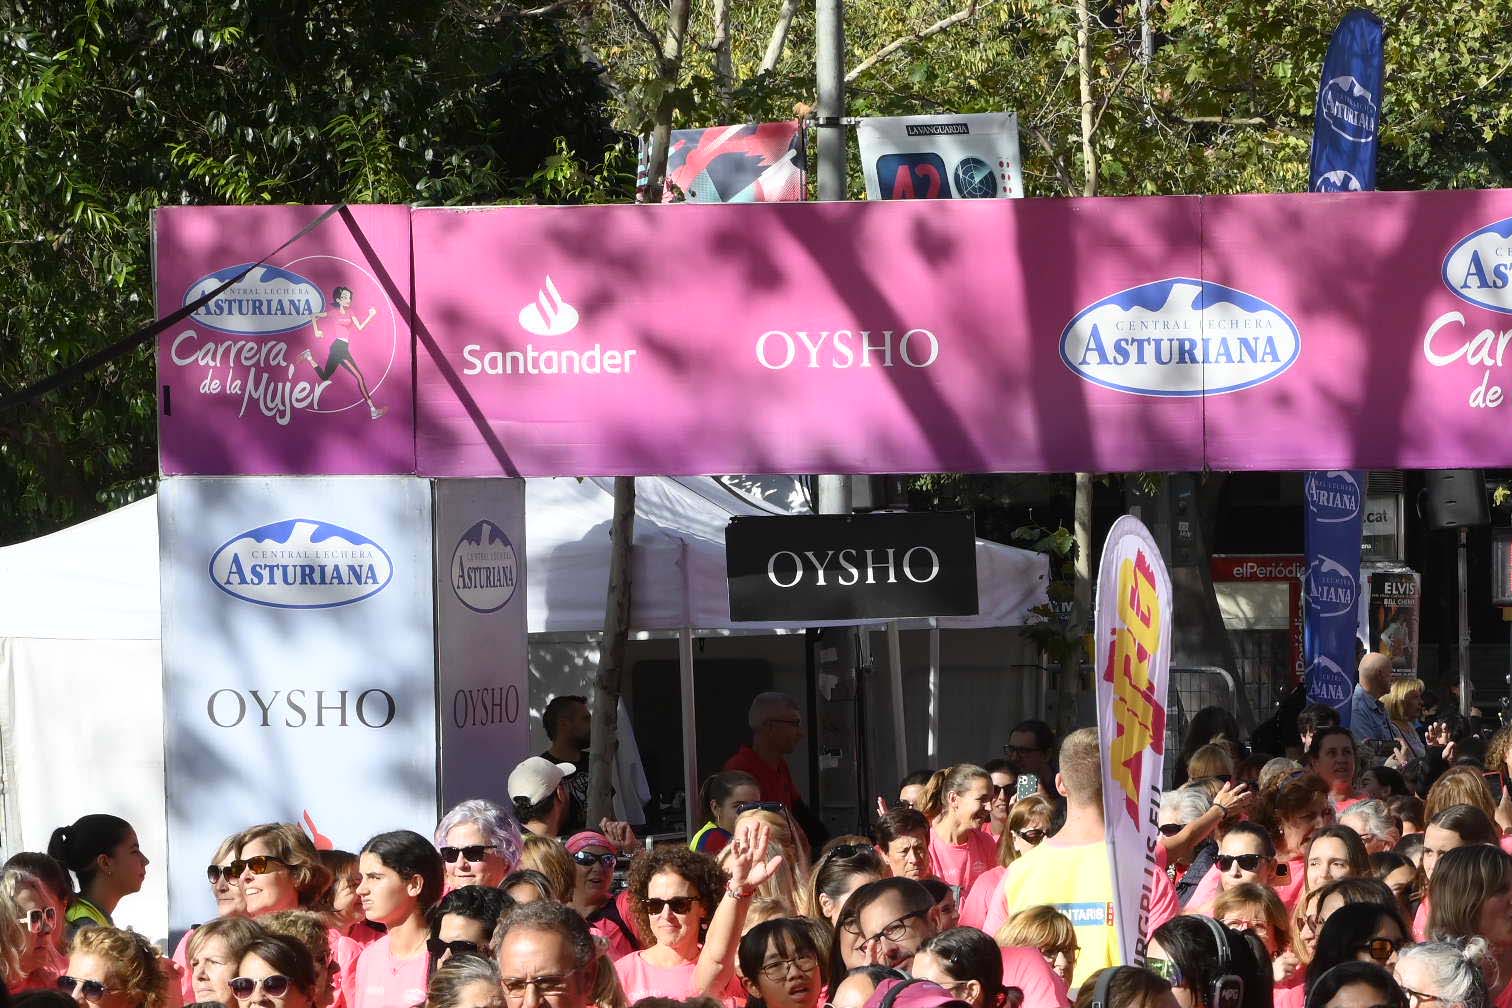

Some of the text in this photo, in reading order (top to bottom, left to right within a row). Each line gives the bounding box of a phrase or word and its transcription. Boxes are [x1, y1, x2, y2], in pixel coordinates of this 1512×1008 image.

[224, 288, 259, 296] ENTRAL
[1115, 320, 1191, 332] CENTRAL
[171, 330, 288, 367] Carrera
[462, 343, 637, 377] Santander
[755, 329, 939, 369] OYSHO
[1079, 323, 1282, 366] ASTURIANA
[200, 364, 332, 425] de la Mujer
[1469, 369, 1504, 408] de
[224, 552, 379, 586] ASTURIANA
[252, 550, 311, 560] CENTRAL
[457, 555, 515, 591] ASTURIANA
[767, 546, 939, 588] OYSHO
[1233, 562, 1305, 579] elPeriódi
[1384, 582, 1414, 595] ELVIS
[207, 688, 396, 729] OYSHO
[453, 685, 519, 729] OYSHO
